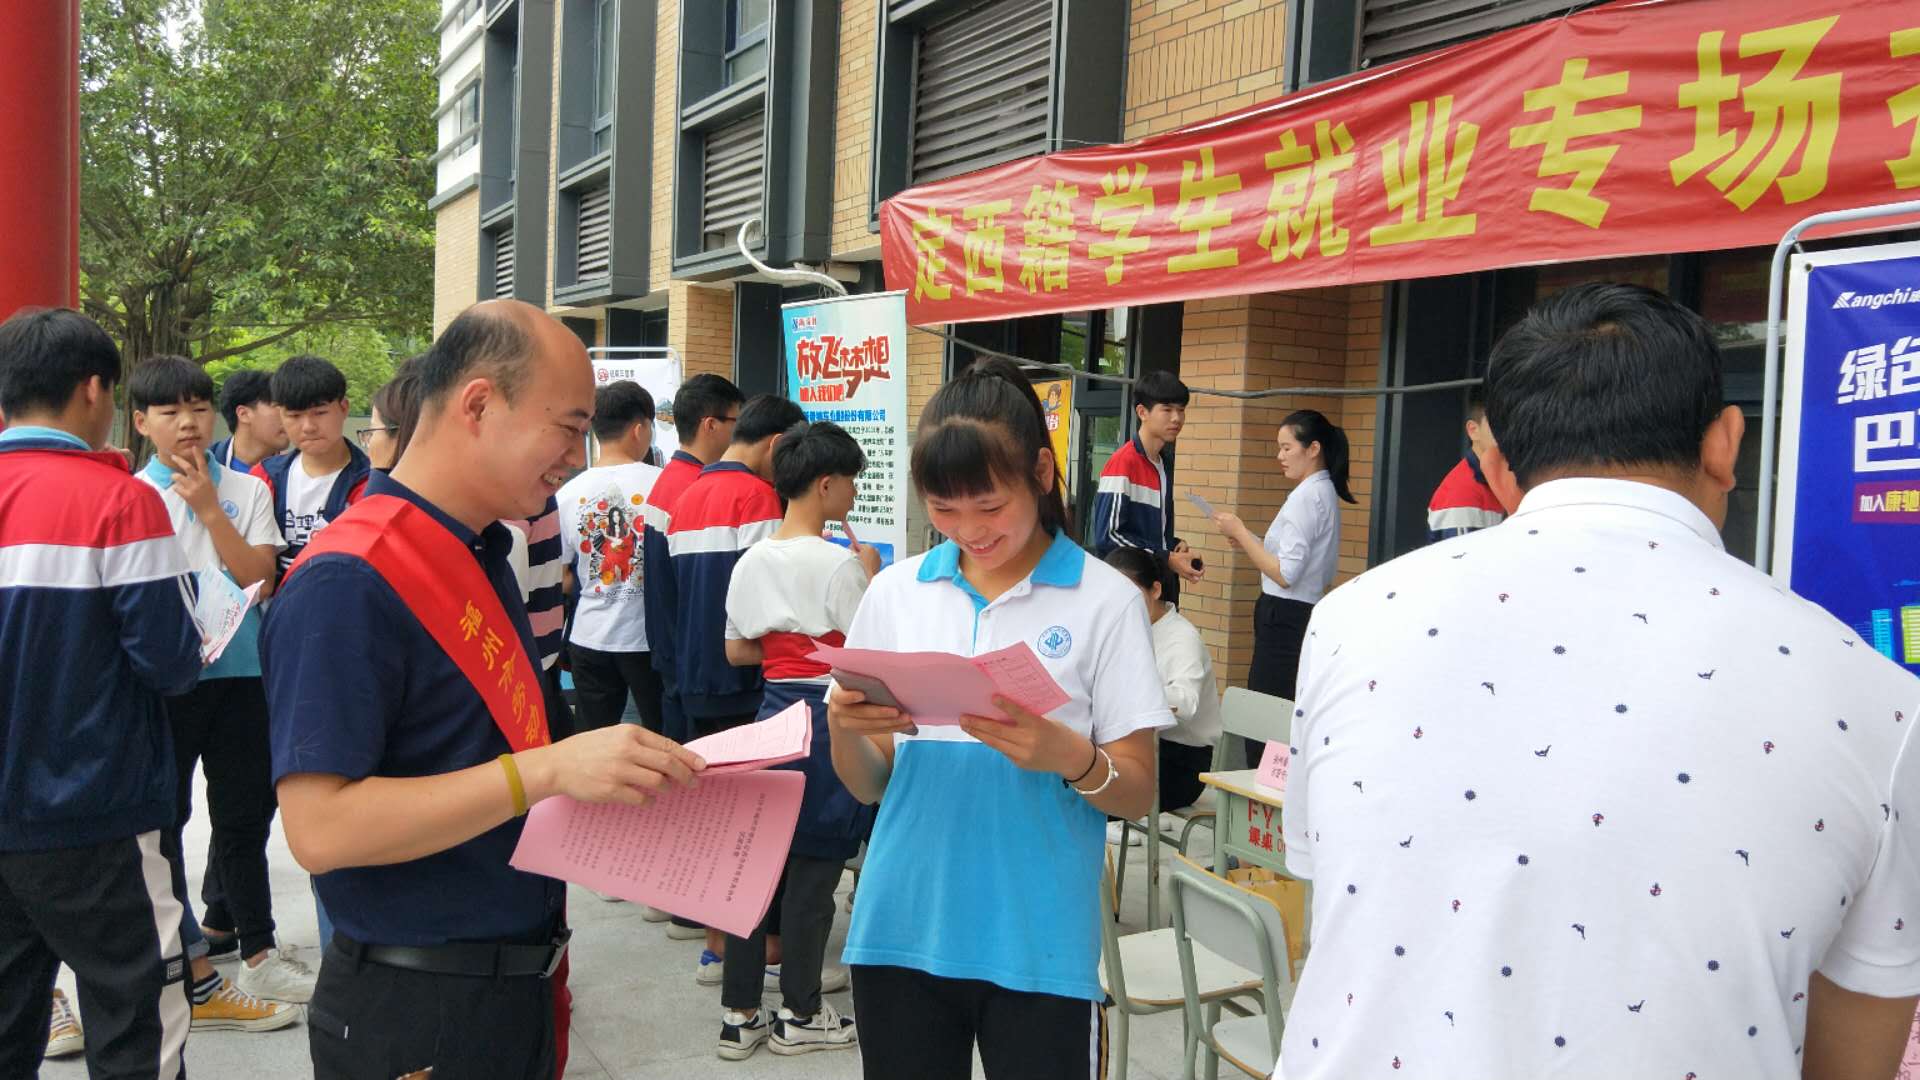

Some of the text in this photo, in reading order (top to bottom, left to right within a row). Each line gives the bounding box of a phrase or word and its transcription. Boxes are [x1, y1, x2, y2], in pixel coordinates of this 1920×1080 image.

[911, 14, 1920, 304] 定西籍学生就业专场
[797, 335, 891, 399] 放飞梦想
[1854, 408, 1920, 472] 巴
[1247, 799, 1284, 837] FY
